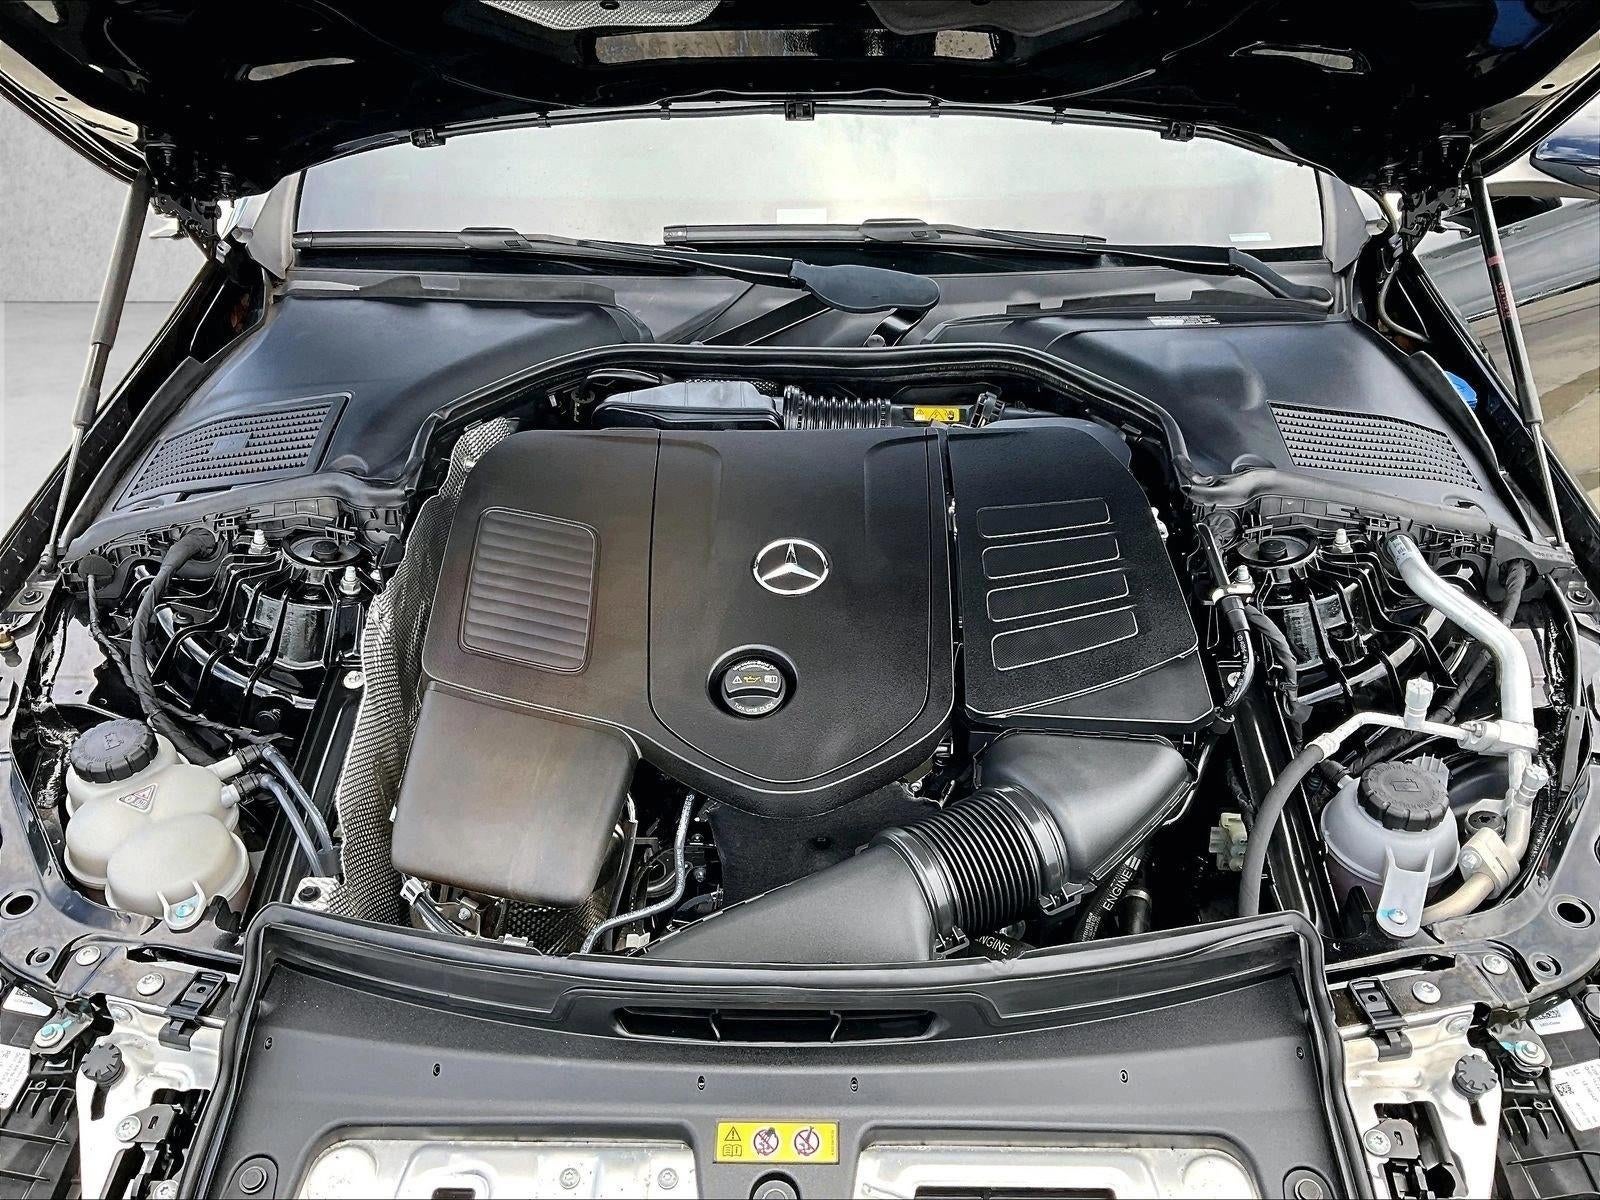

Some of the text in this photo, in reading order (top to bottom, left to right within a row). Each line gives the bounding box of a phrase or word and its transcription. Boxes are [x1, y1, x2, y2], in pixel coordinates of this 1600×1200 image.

[759, 701, 775, 711] CLICK
[1102, 867, 1132, 911] ENGINE
[975, 936, 1011, 956] NGINE
